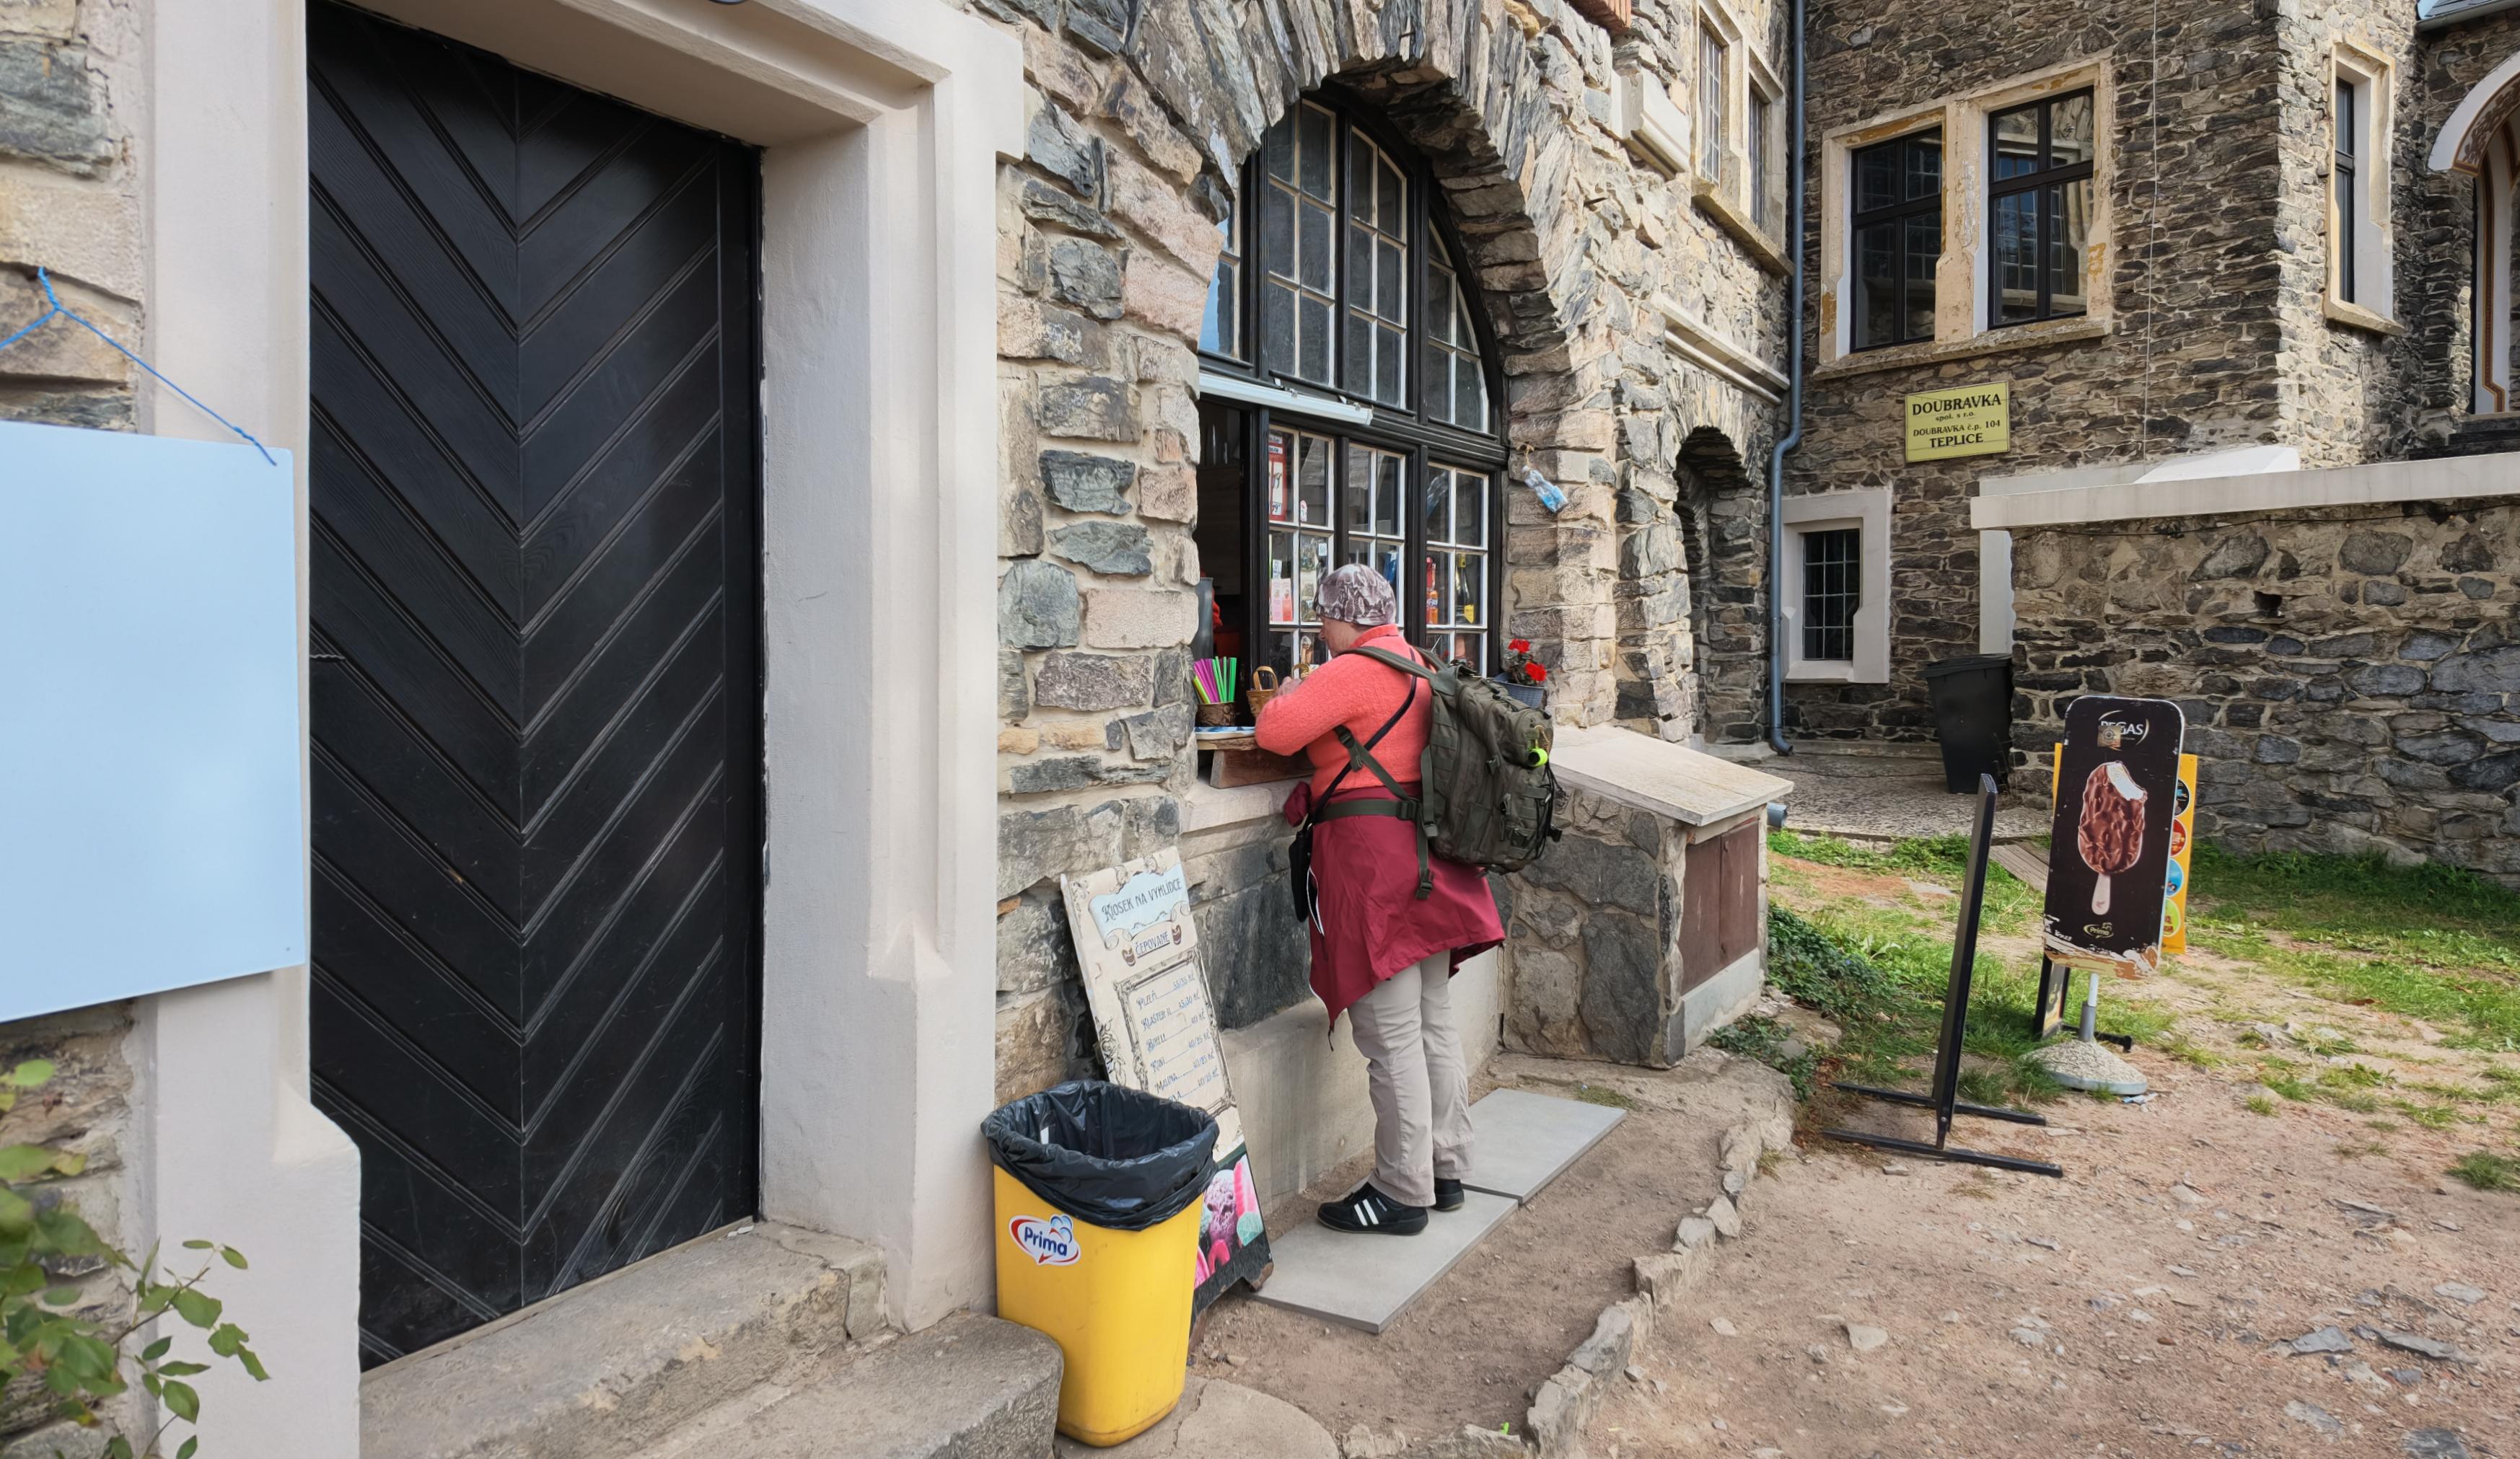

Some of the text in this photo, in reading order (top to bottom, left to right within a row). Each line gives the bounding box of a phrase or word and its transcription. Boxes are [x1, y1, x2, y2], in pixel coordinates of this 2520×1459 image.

[1913, 393, 2001, 415] DOUBRAVKA
[1935, 412, 1954, 422] spol.
[1913, 419, 2001, 437] DOUBRAVKA č.p. 104
[1929, 433, 1984, 449] TEPLICE
[1102, 896, 1133, 923] KIOSEK
[1136, 892, 1147, 907] NA
[2089, 927, 2109, 935] Prima
[1024, 1225, 1068, 1257] Prima
